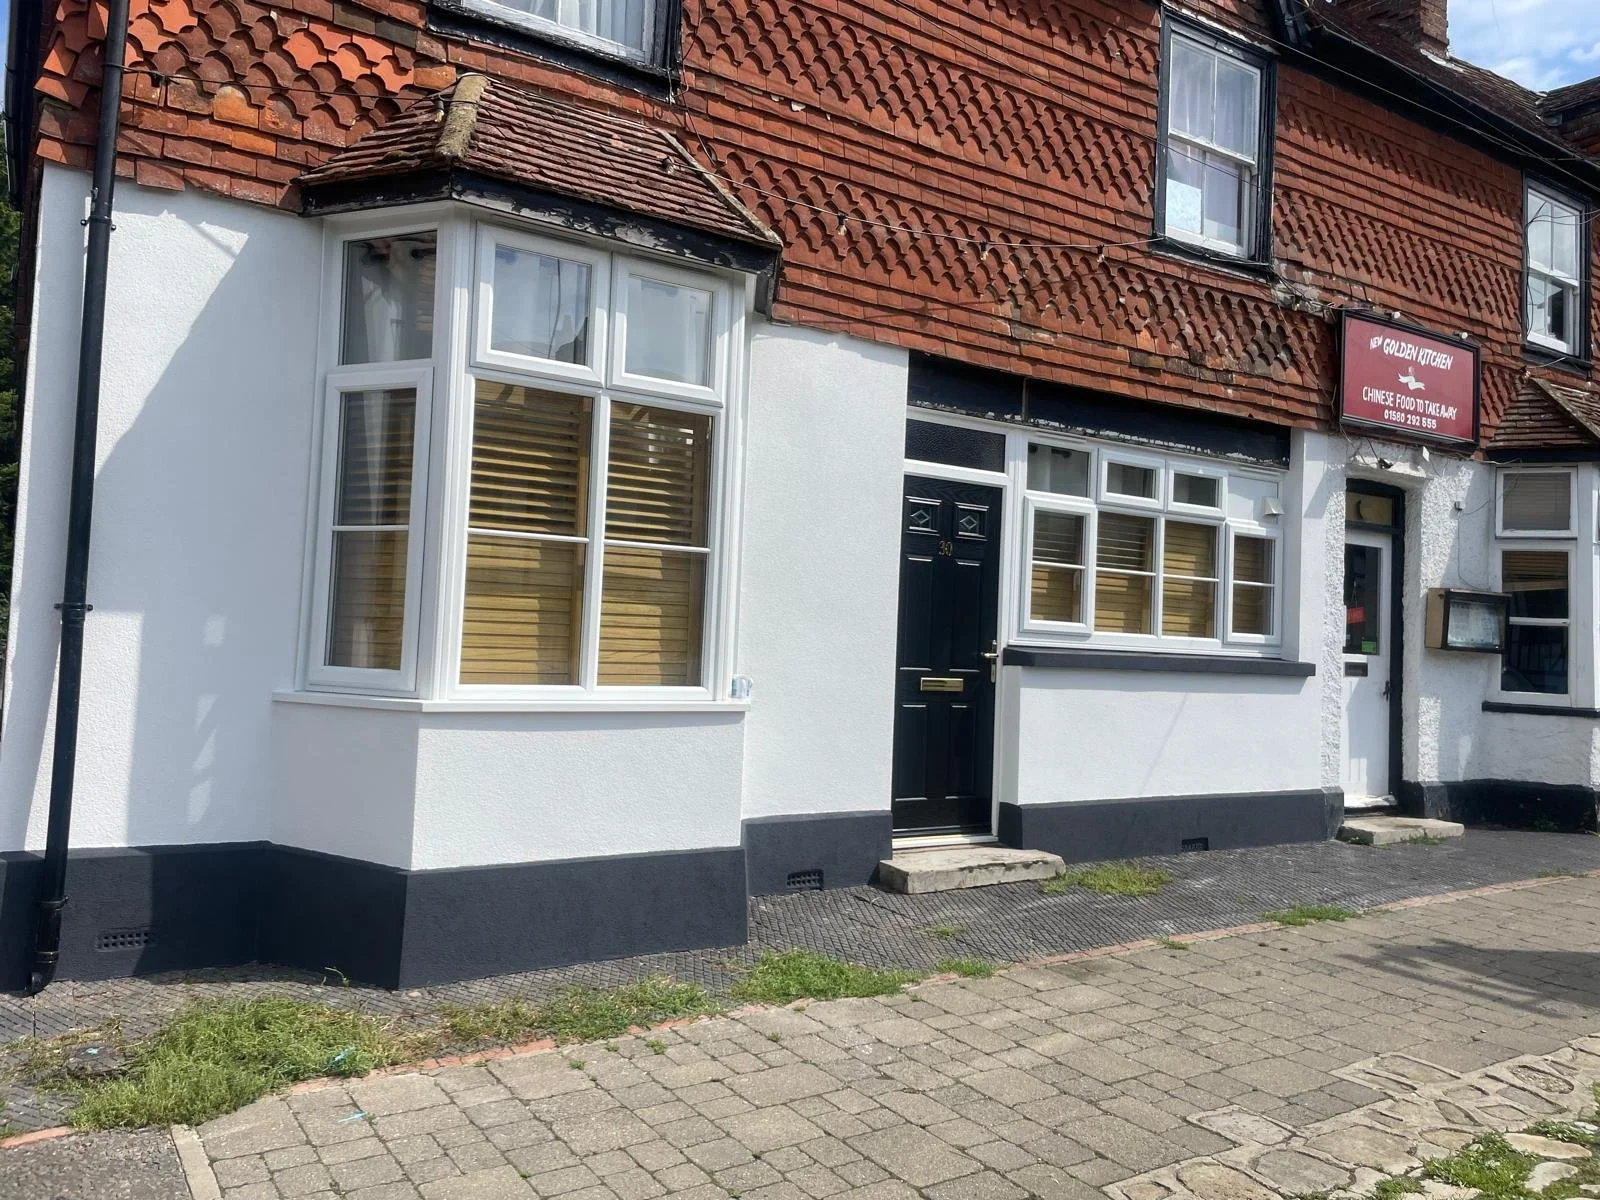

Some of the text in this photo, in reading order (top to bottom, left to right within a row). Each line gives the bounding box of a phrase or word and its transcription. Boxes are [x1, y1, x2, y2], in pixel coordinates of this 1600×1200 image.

[1370, 335, 1454, 370] NEW GOLDEN KITCHEN
[1362, 386, 1394, 406] CHINESE
[1396, 393, 1415, 411] FOOD
[1416, 399, 1424, 413] TO
[1384, 409, 1405, 422] 01580
[1406, 414, 1420, 425] 292
[938, 540, 953, 557] 30
